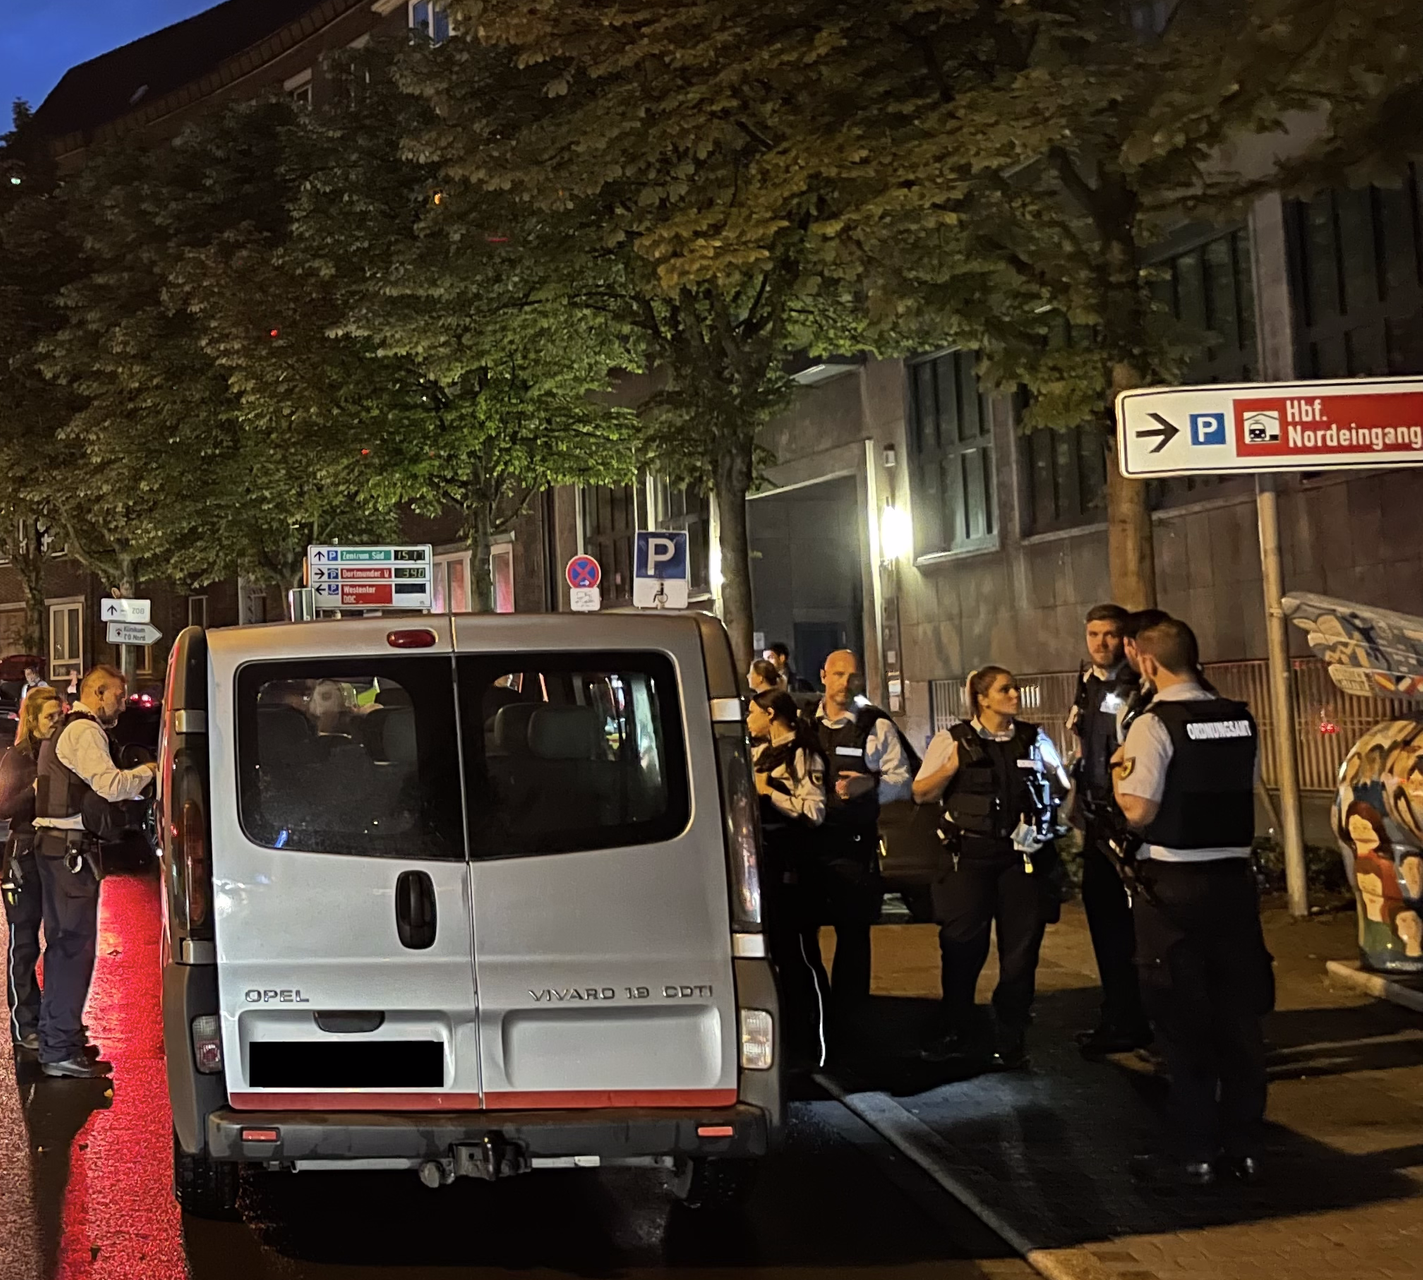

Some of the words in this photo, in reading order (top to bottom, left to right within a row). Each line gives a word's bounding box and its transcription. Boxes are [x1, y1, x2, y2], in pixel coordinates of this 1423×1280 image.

[1286, 399, 1327, 422] Hbf.
[1197, 416, 1217, 442] P
[1288, 422, 1423, 450] Nordeingang
[329, 551, 337, 560] P
[342, 551, 369, 560] Zentrum
[372, 551, 385, 560] Süd
[647, 538, 675, 576] P
[342, 569, 381, 578] Dortmunder
[343, 586, 376, 594] Westentor
[245, 989, 310, 1003] OPEL
[528, 987, 615, 1002] VIVARO
[662, 985, 713, 998] CDTI
